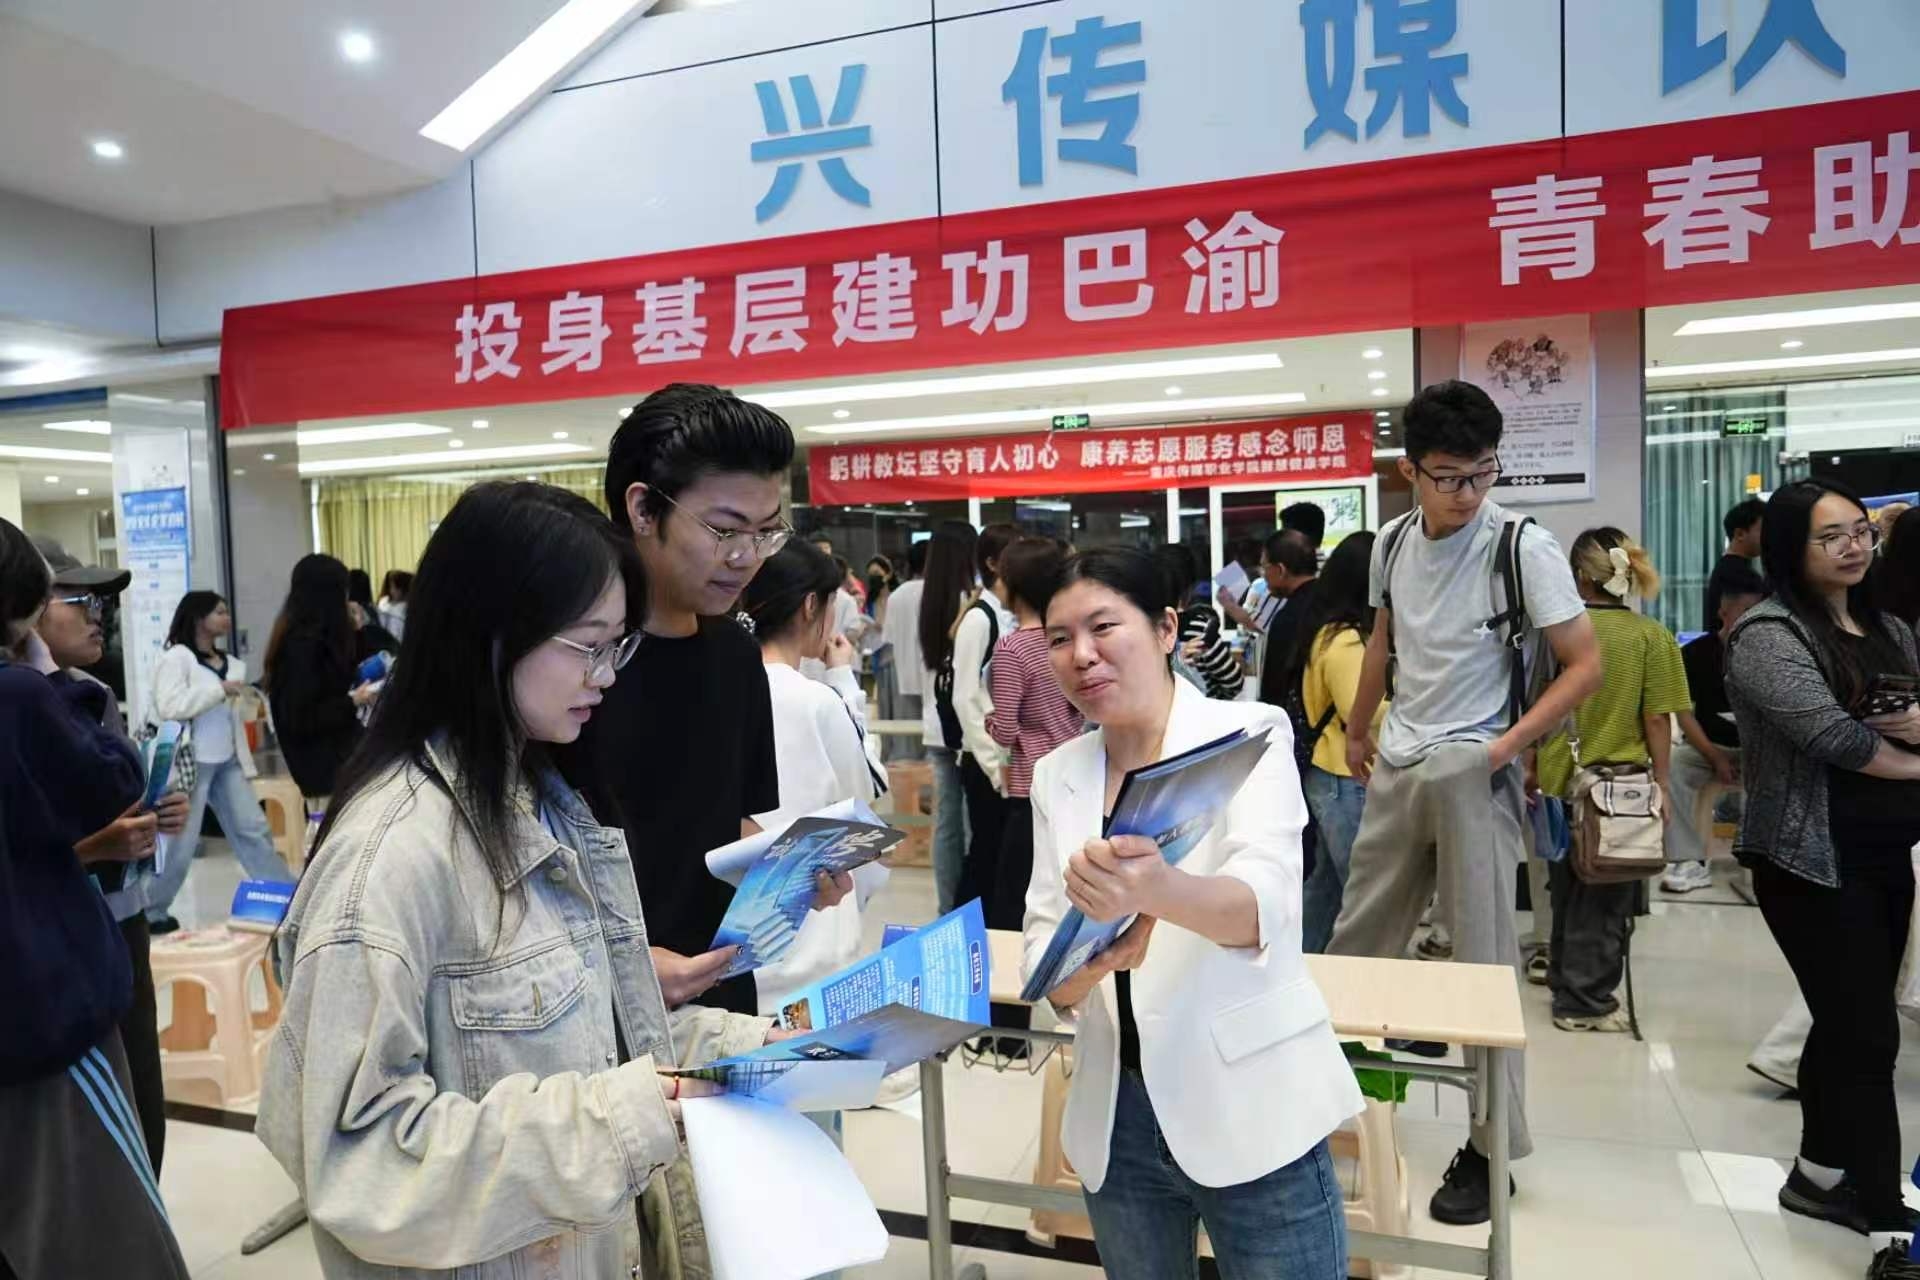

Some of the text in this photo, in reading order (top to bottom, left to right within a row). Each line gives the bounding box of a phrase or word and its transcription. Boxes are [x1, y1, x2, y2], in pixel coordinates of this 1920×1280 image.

[454, 130, 1920, 385] 投身基层建功巴渝 青春助
[829, 423, 1347, 482] 躬耕教坛坚守育人初心 康养志愿服务感念师恩
